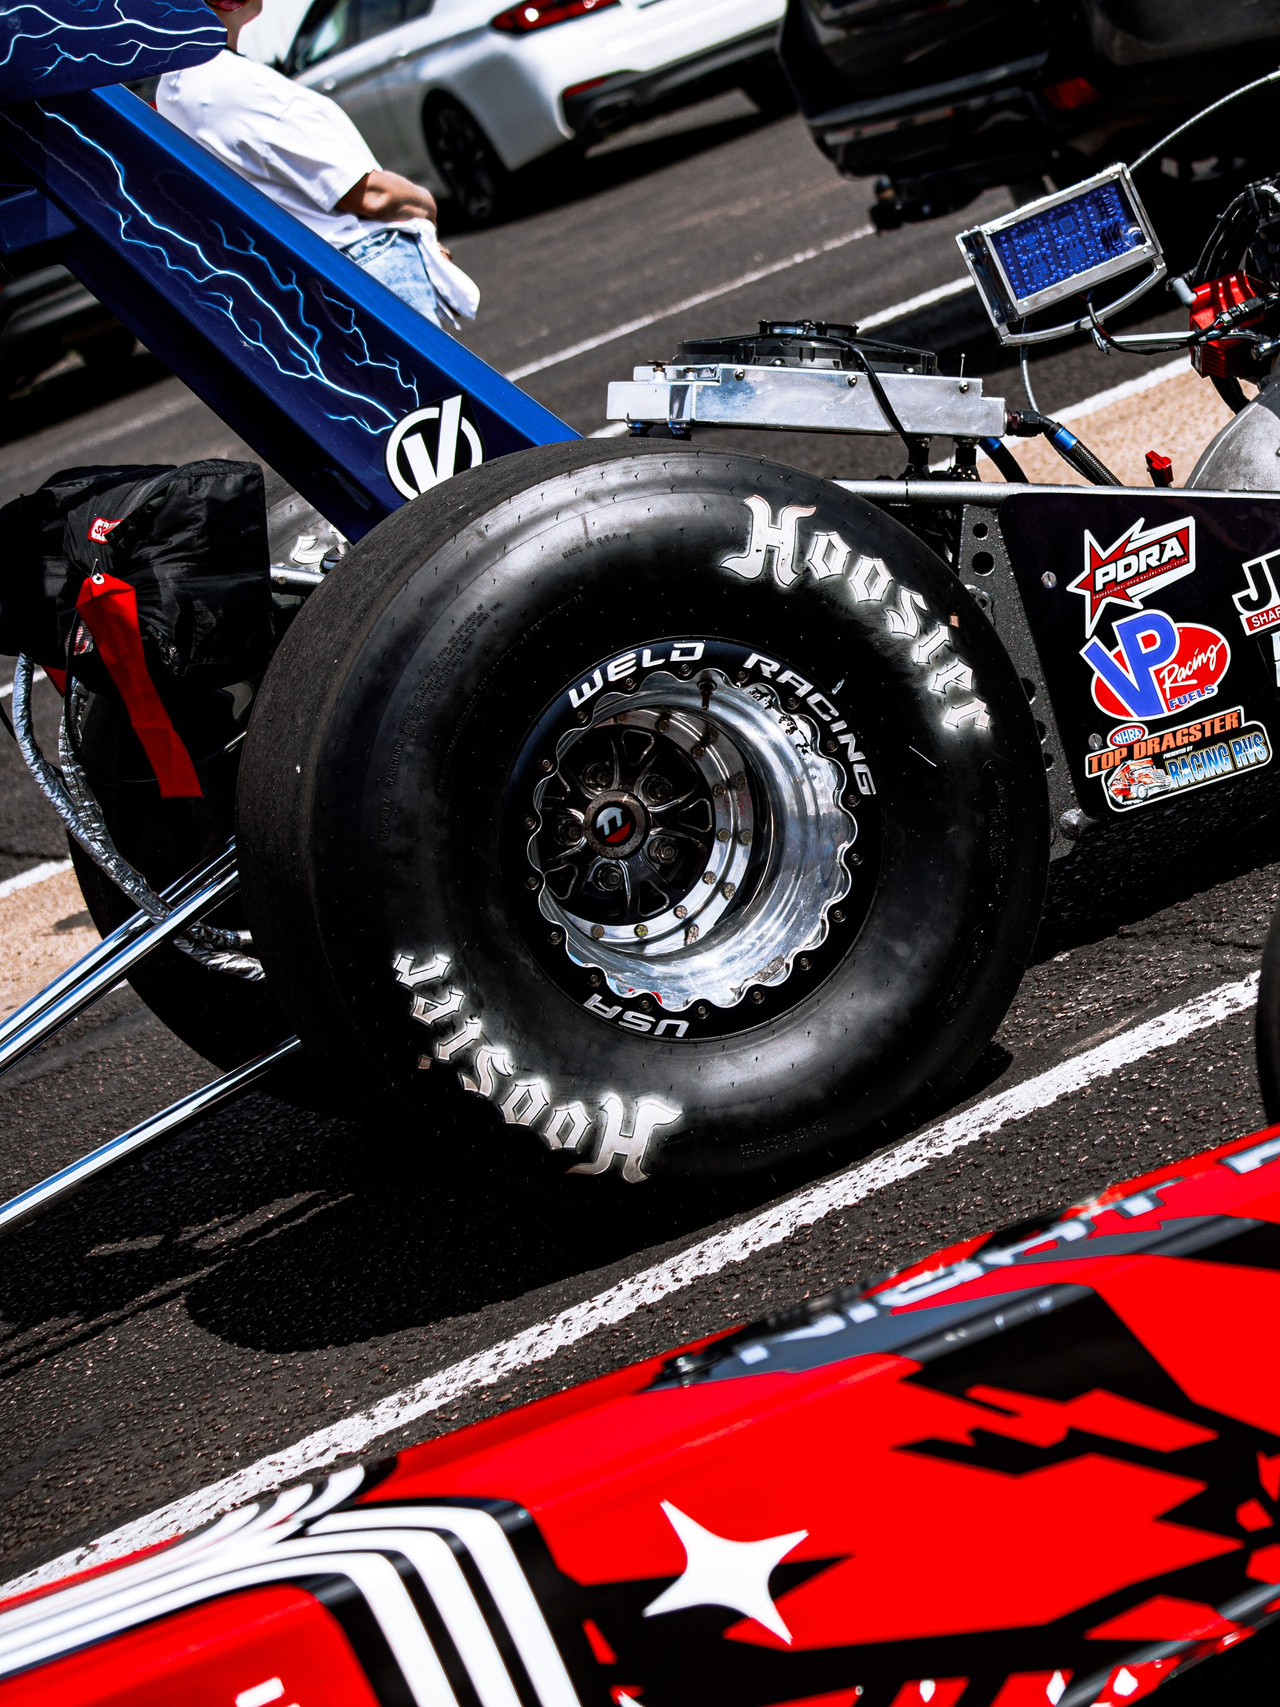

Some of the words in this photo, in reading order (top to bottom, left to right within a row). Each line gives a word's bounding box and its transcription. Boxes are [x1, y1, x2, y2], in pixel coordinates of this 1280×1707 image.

[561, 545, 584, 559] MADE
[584, 540, 594, 549] IN
[1095, 536, 1185, 592] PDRA
[1083, 613, 1178, 718] VP
[1159, 645, 1224, 699] Racing
[568, 642, 705, 709] WELD
[743, 653, 877, 796] RACING
[1168, 684, 1216, 710] FUELS
[1088, 747, 1129, 774] TOP
[1133, 711, 1240, 760] DRAGSTER
[1112, 726, 1143, 745] NHRA
[384, 739, 405, 787] WARNING
[1165, 744, 1234, 791] RACING
[379, 797, 392, 842] SAFETY
[583, 993, 689, 1038] USA
